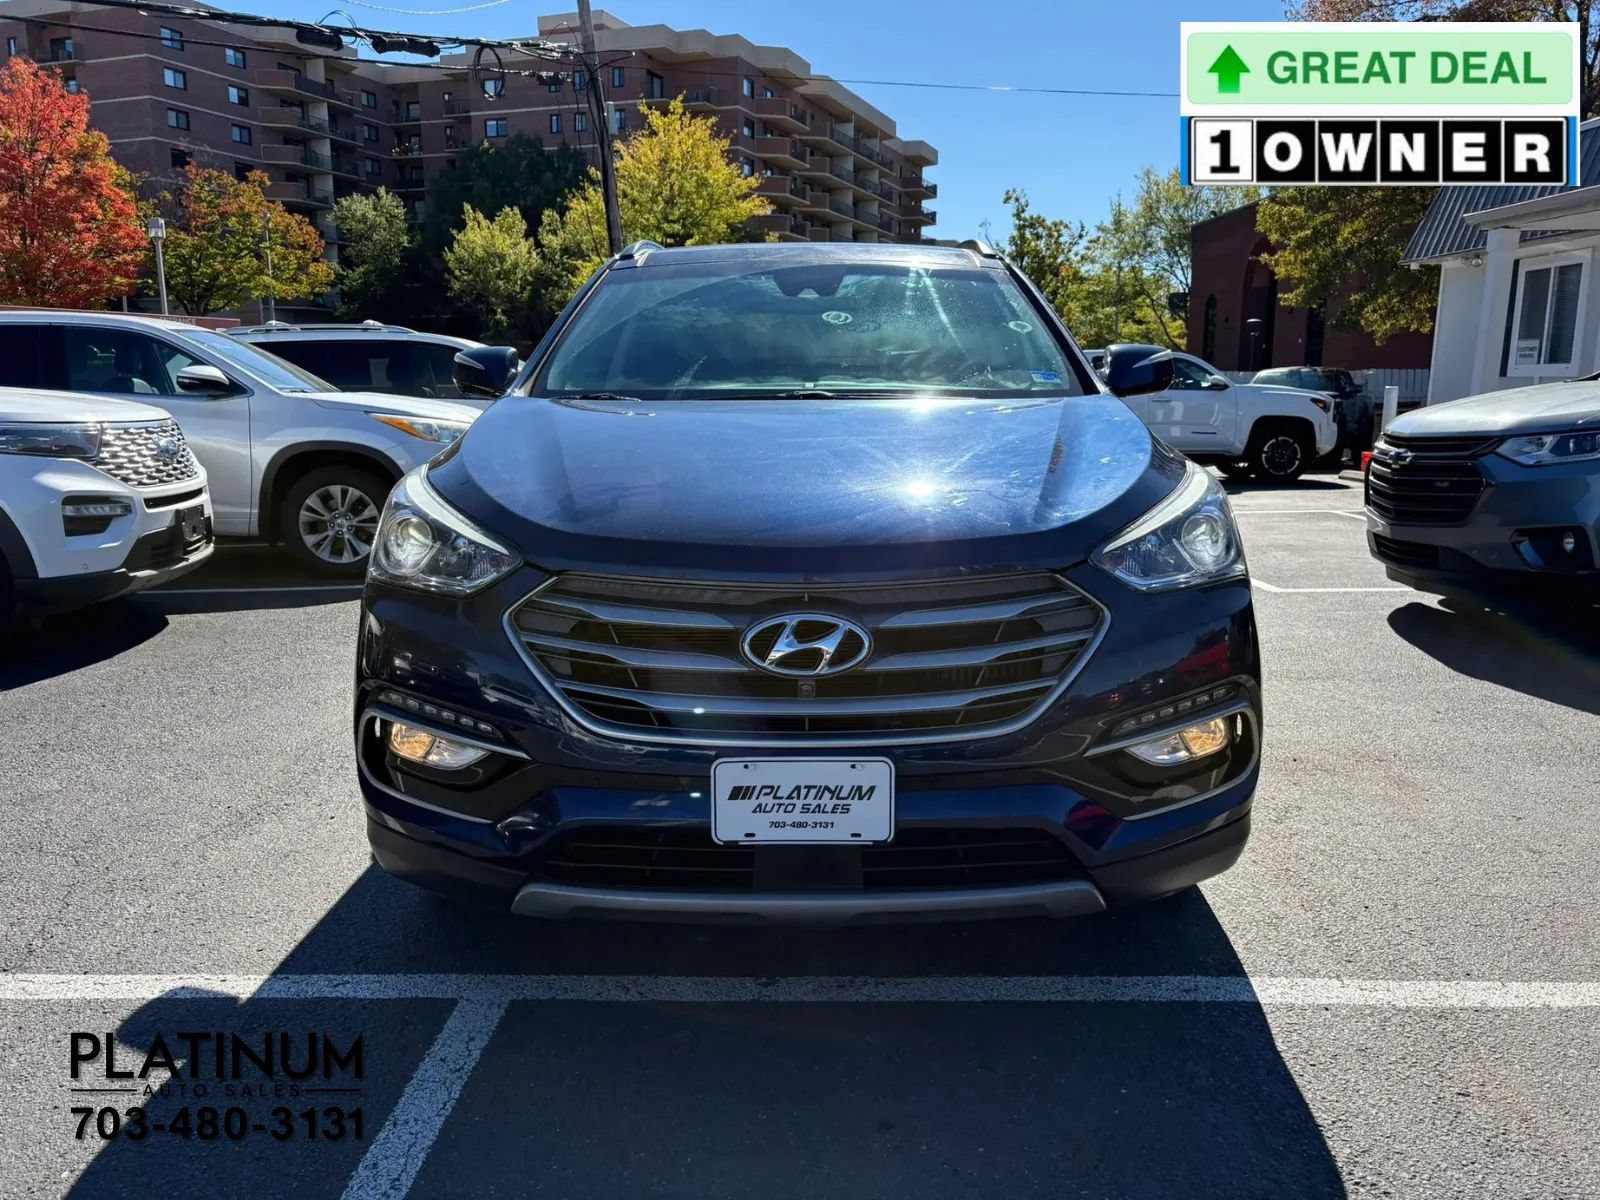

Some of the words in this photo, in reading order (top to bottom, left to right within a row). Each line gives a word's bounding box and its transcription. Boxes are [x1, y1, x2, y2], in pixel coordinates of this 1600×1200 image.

[756, 785, 877, 801] PLATINUM
[752, 803, 796, 814] AUTO
[800, 803, 851, 814] SALES
[769, 821, 835, 829] 703-480-3131
